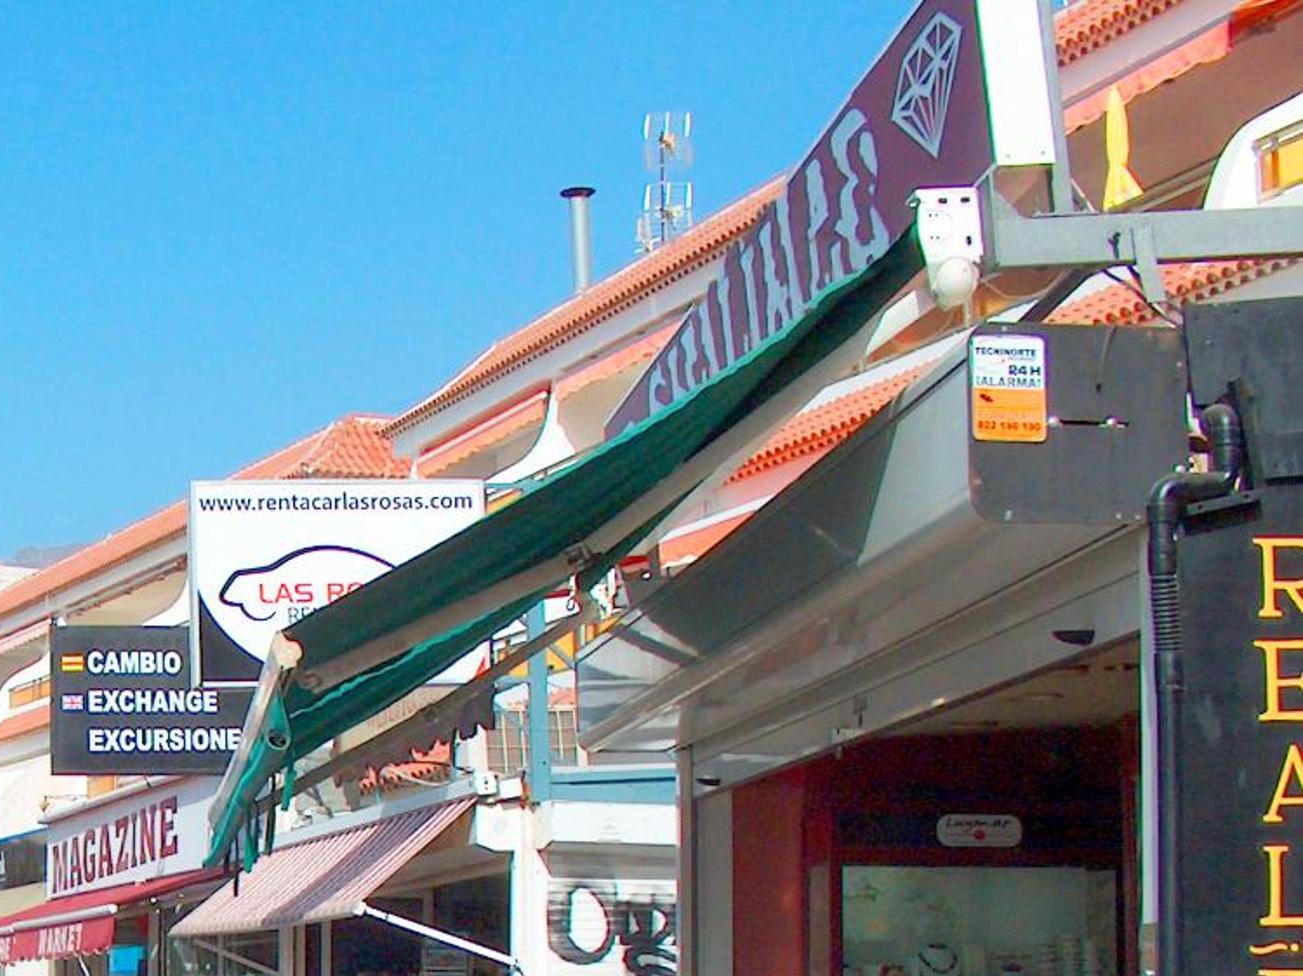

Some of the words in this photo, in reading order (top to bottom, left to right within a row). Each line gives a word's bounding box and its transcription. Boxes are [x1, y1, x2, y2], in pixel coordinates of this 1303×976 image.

[199, 492, 473, 511] www.rentacarlasrosas.com
[259, 583, 313, 604] LAS
[87, 651, 182, 674] CAMBIO
[87, 690, 218, 713] EXCHANGE
[88, 728, 243, 751] EXCURSIONE
[51, 796, 179, 895] MAGAZINE
